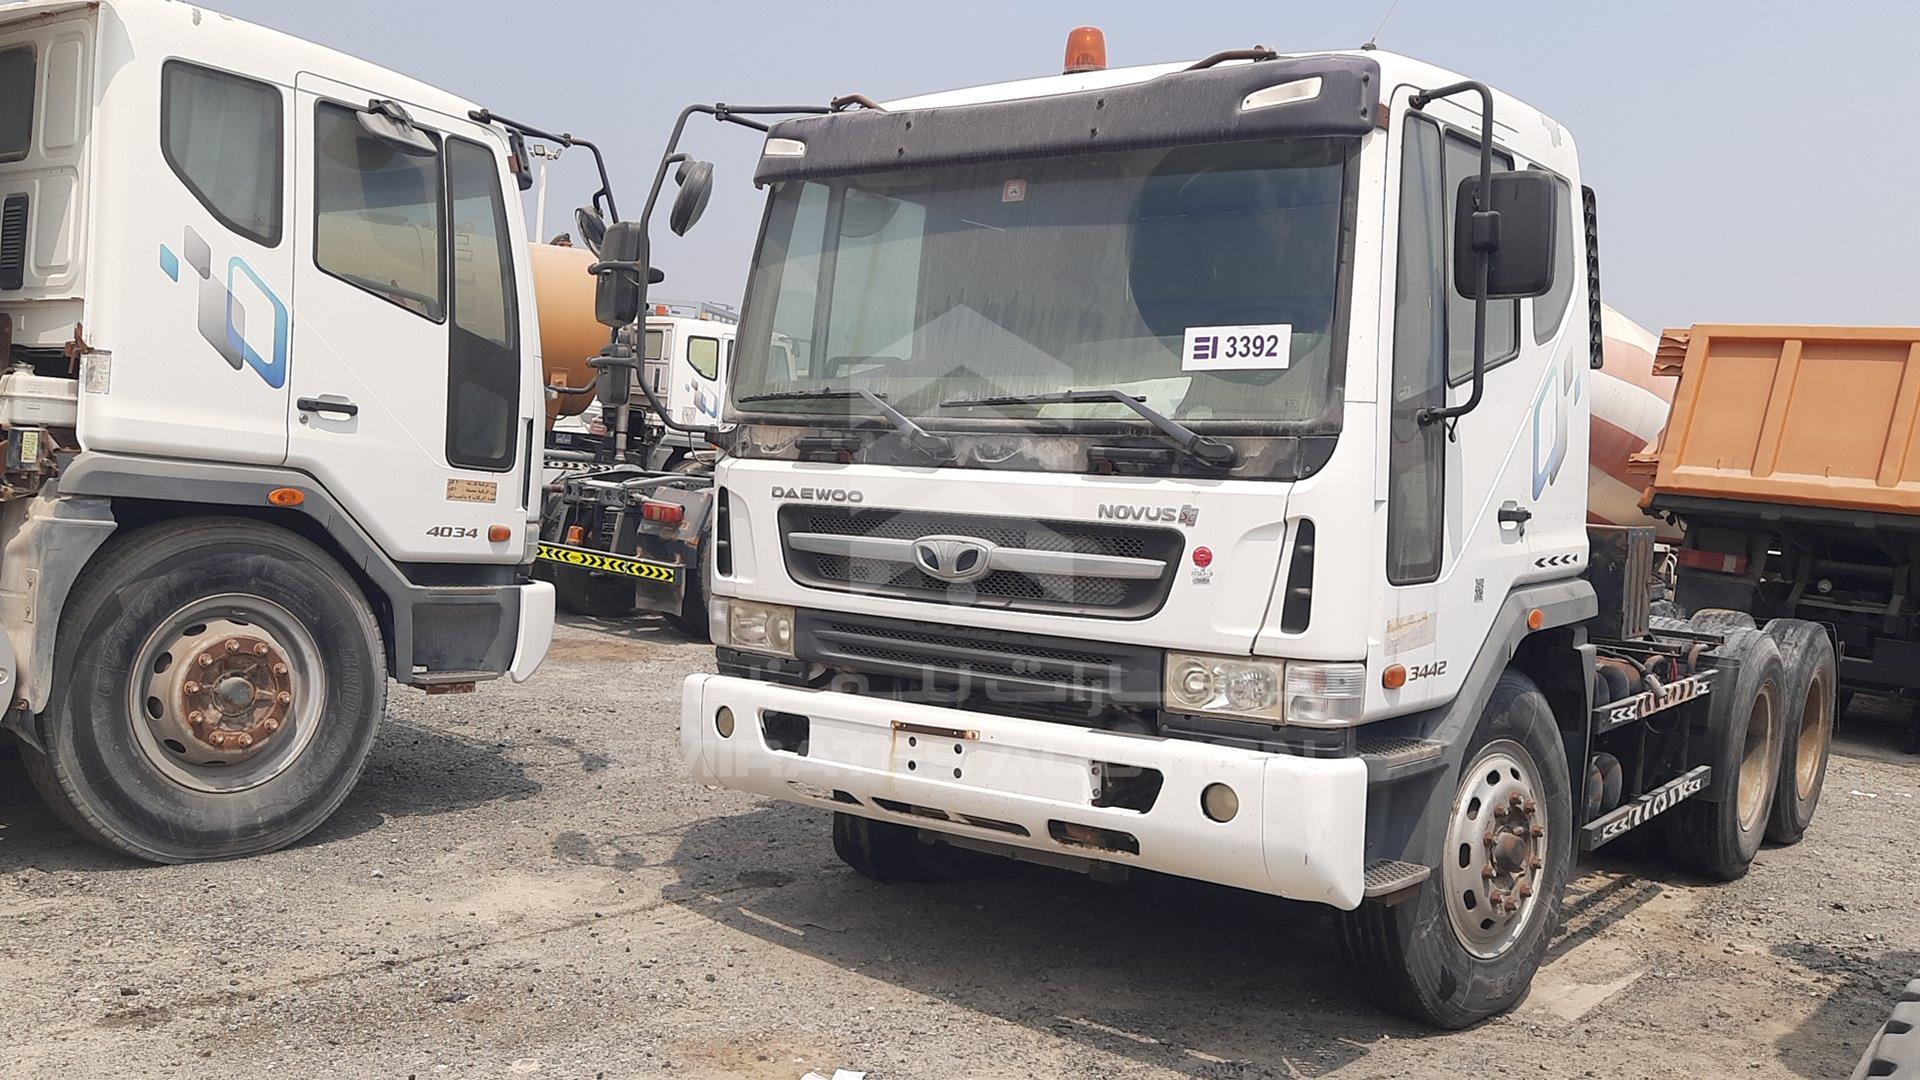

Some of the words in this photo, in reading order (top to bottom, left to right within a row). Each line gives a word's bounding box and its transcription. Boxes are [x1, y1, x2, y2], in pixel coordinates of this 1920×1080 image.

[1225, 335, 1279, 358] 3392
[771, 486, 864, 503] DAEWOO
[1098, 503, 1177, 525] NOVUS
[426, 526, 478, 538] 4034
[1409, 661, 1447, 681] 3442
